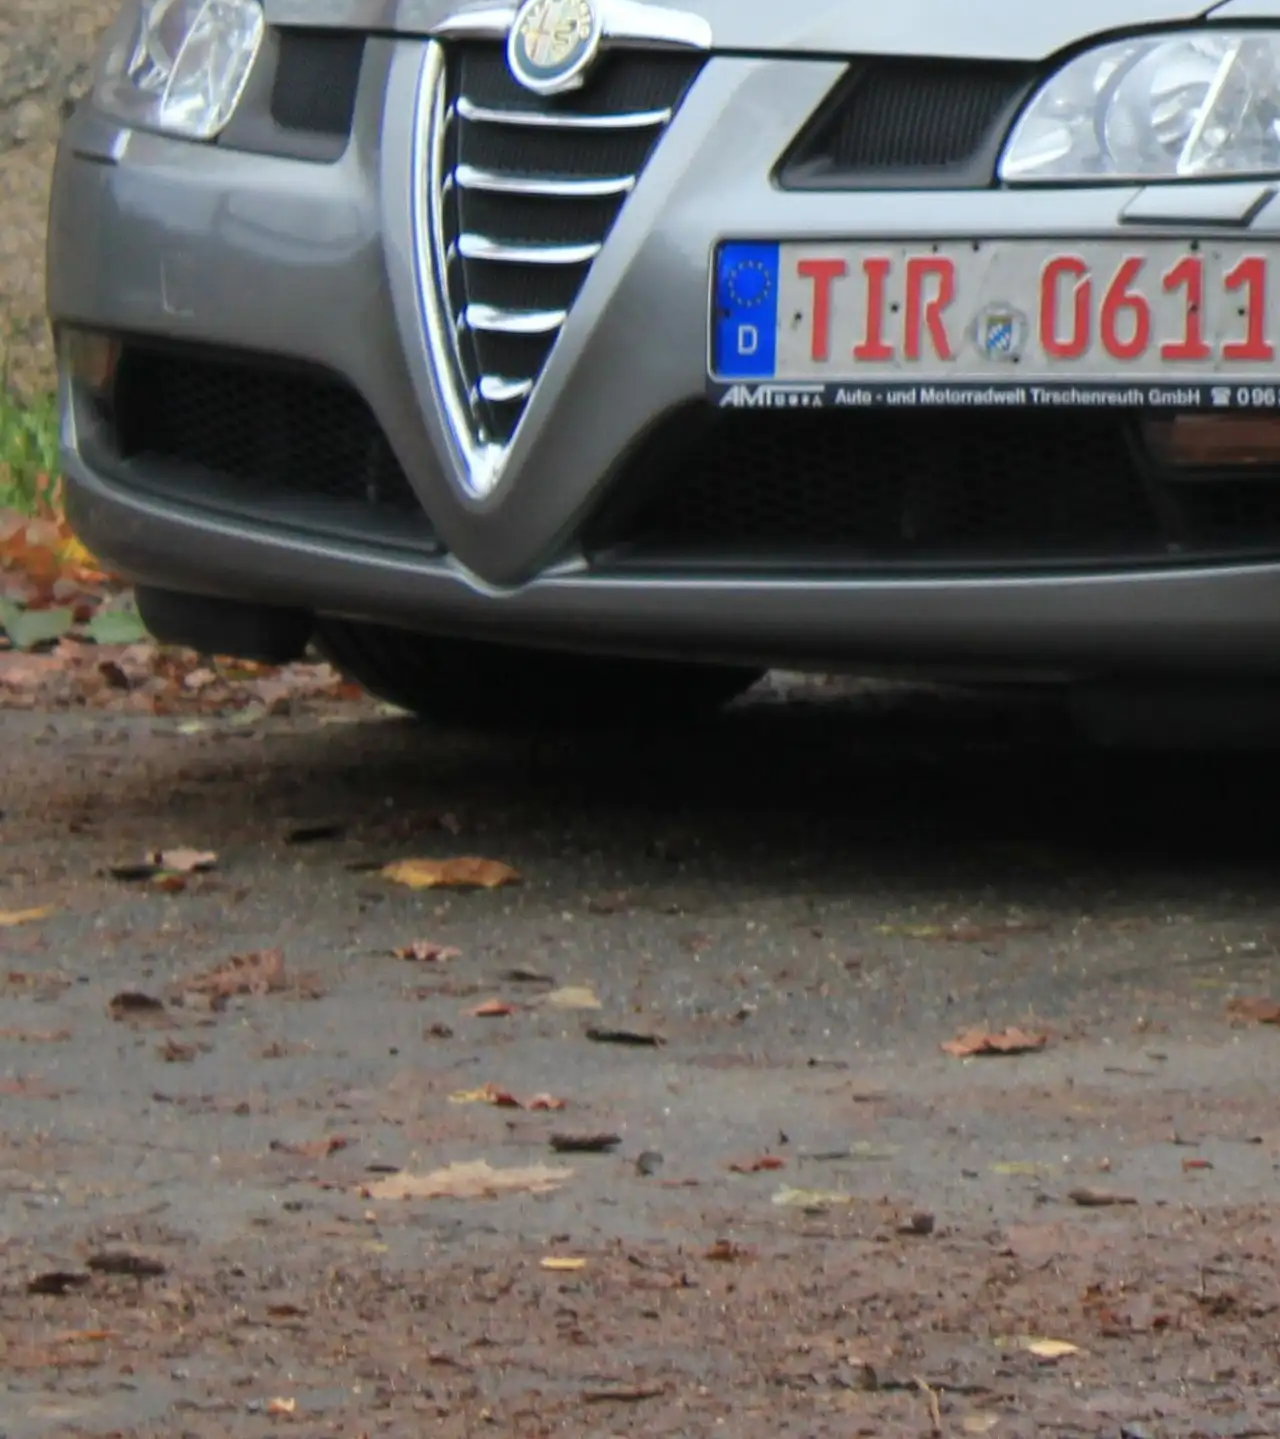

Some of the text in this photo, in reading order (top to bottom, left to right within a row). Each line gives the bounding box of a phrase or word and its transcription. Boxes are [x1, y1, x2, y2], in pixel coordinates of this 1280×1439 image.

[797, 258, 956, 361] TIR
[737, 325, 758, 356] D
[835, 387, 872, 405] Auto
[886, 387, 916, 405] und
[920, 386, 1026, 406] Motorradwelt
[1030, 386, 1145, 406] Tirschenreuth
[1148, 387, 1201, 407] GmbH
